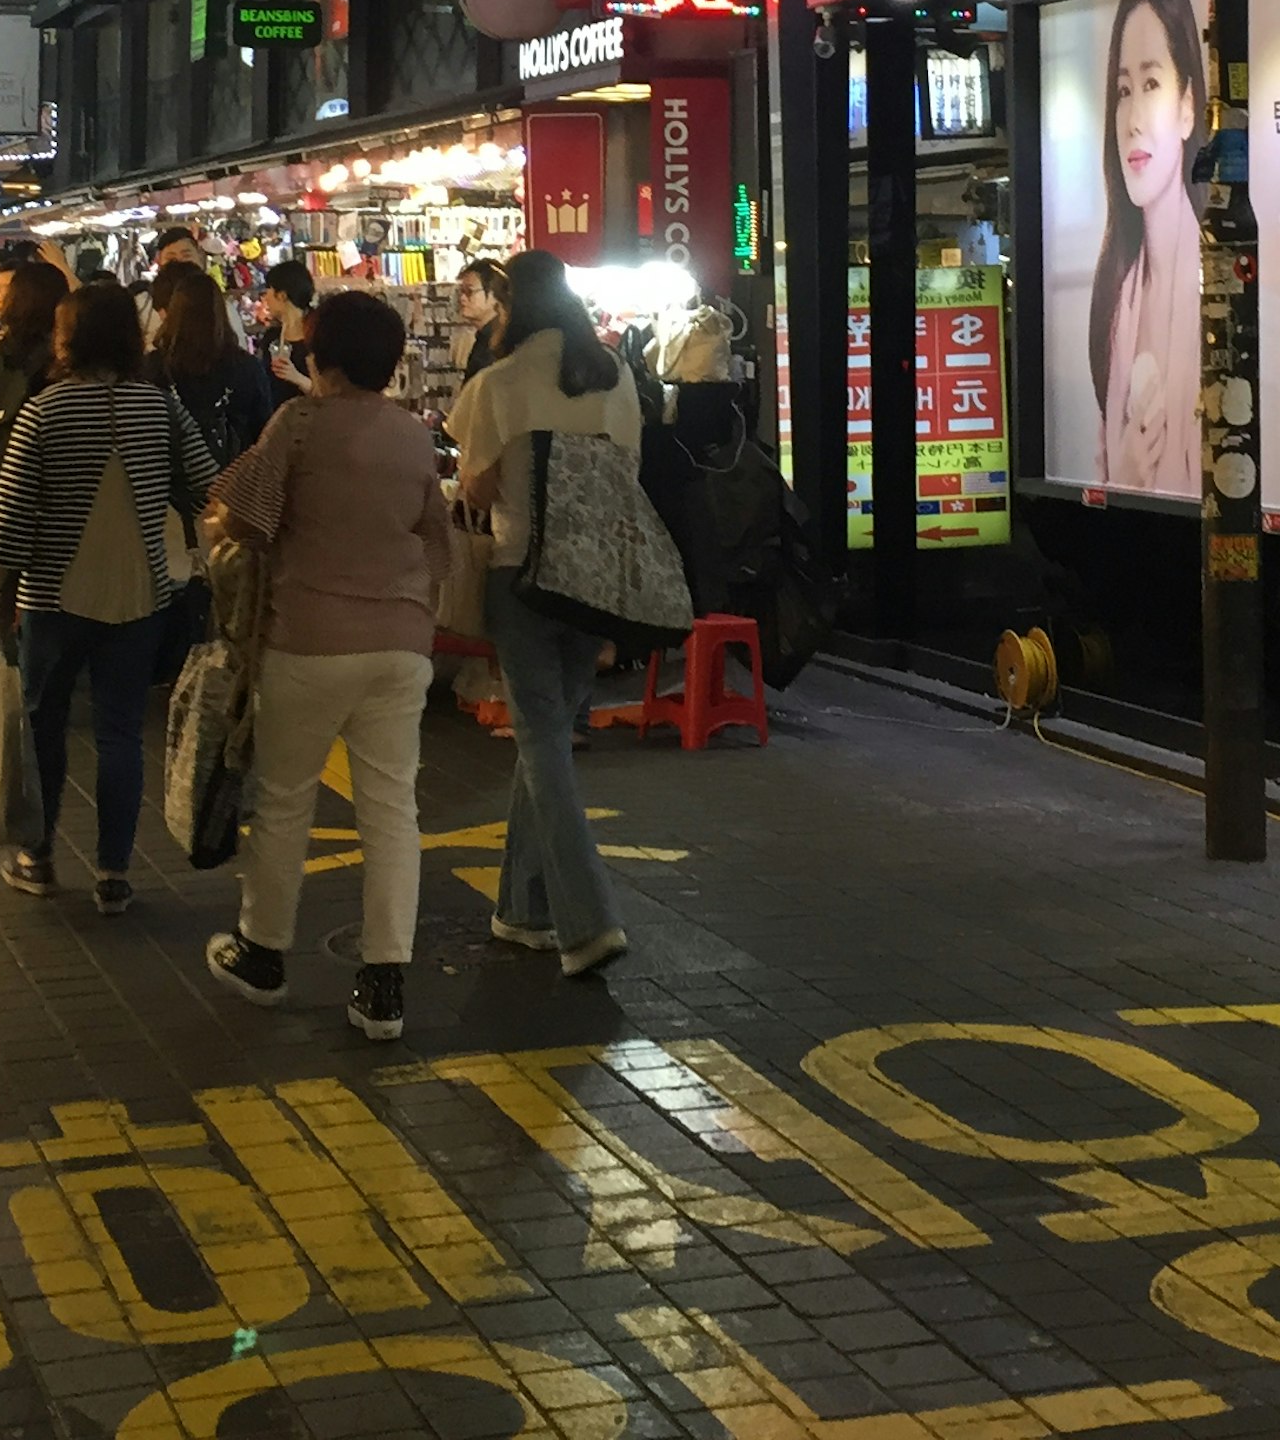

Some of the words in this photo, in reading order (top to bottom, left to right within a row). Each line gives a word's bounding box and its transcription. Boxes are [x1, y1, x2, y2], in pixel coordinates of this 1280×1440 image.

[240, 9, 316, 23] BEANSBINS
[254, 25, 304, 40] COFFEE
[519, 29, 570, 81] HOLLYS
[569, 17, 625, 68] COFFEE
[662, 97, 690, 215] HOLLYS
